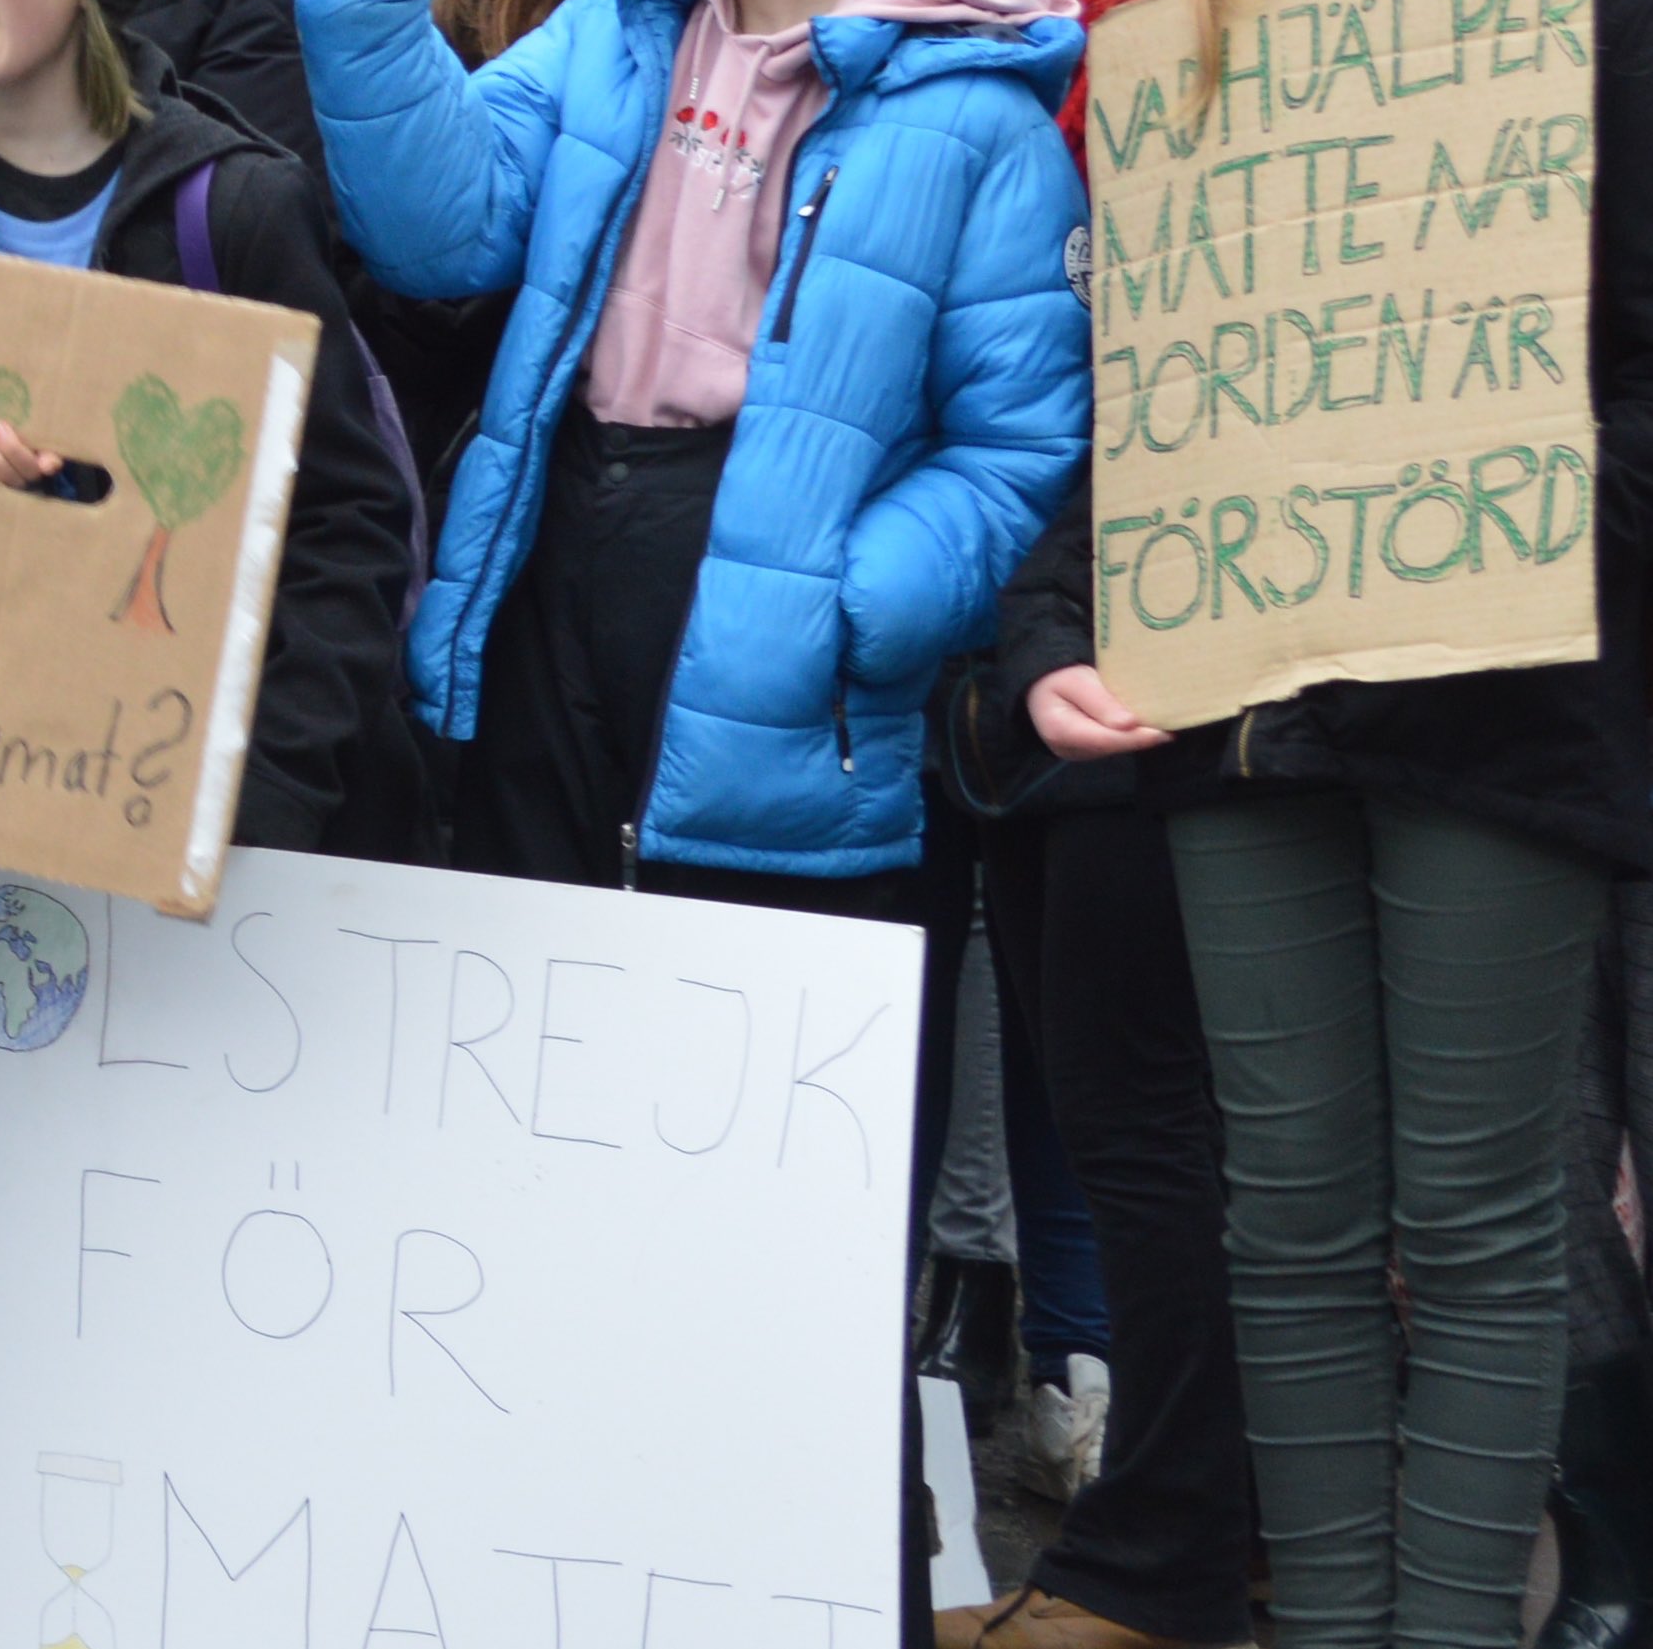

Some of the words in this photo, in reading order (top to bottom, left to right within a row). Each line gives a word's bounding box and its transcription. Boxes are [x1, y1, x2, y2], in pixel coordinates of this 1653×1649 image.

[1100, 134, 1394, 338] MATTE
[1414, 113, 1592, 250] NÄR
[1100, 288, 1433, 462] JORDEN
[1450, 293, 1563, 400] ÄR
[1097, 442, 1593, 650] FÖRSTÖRD
[76, 1160, 512, 1415] FÖR
